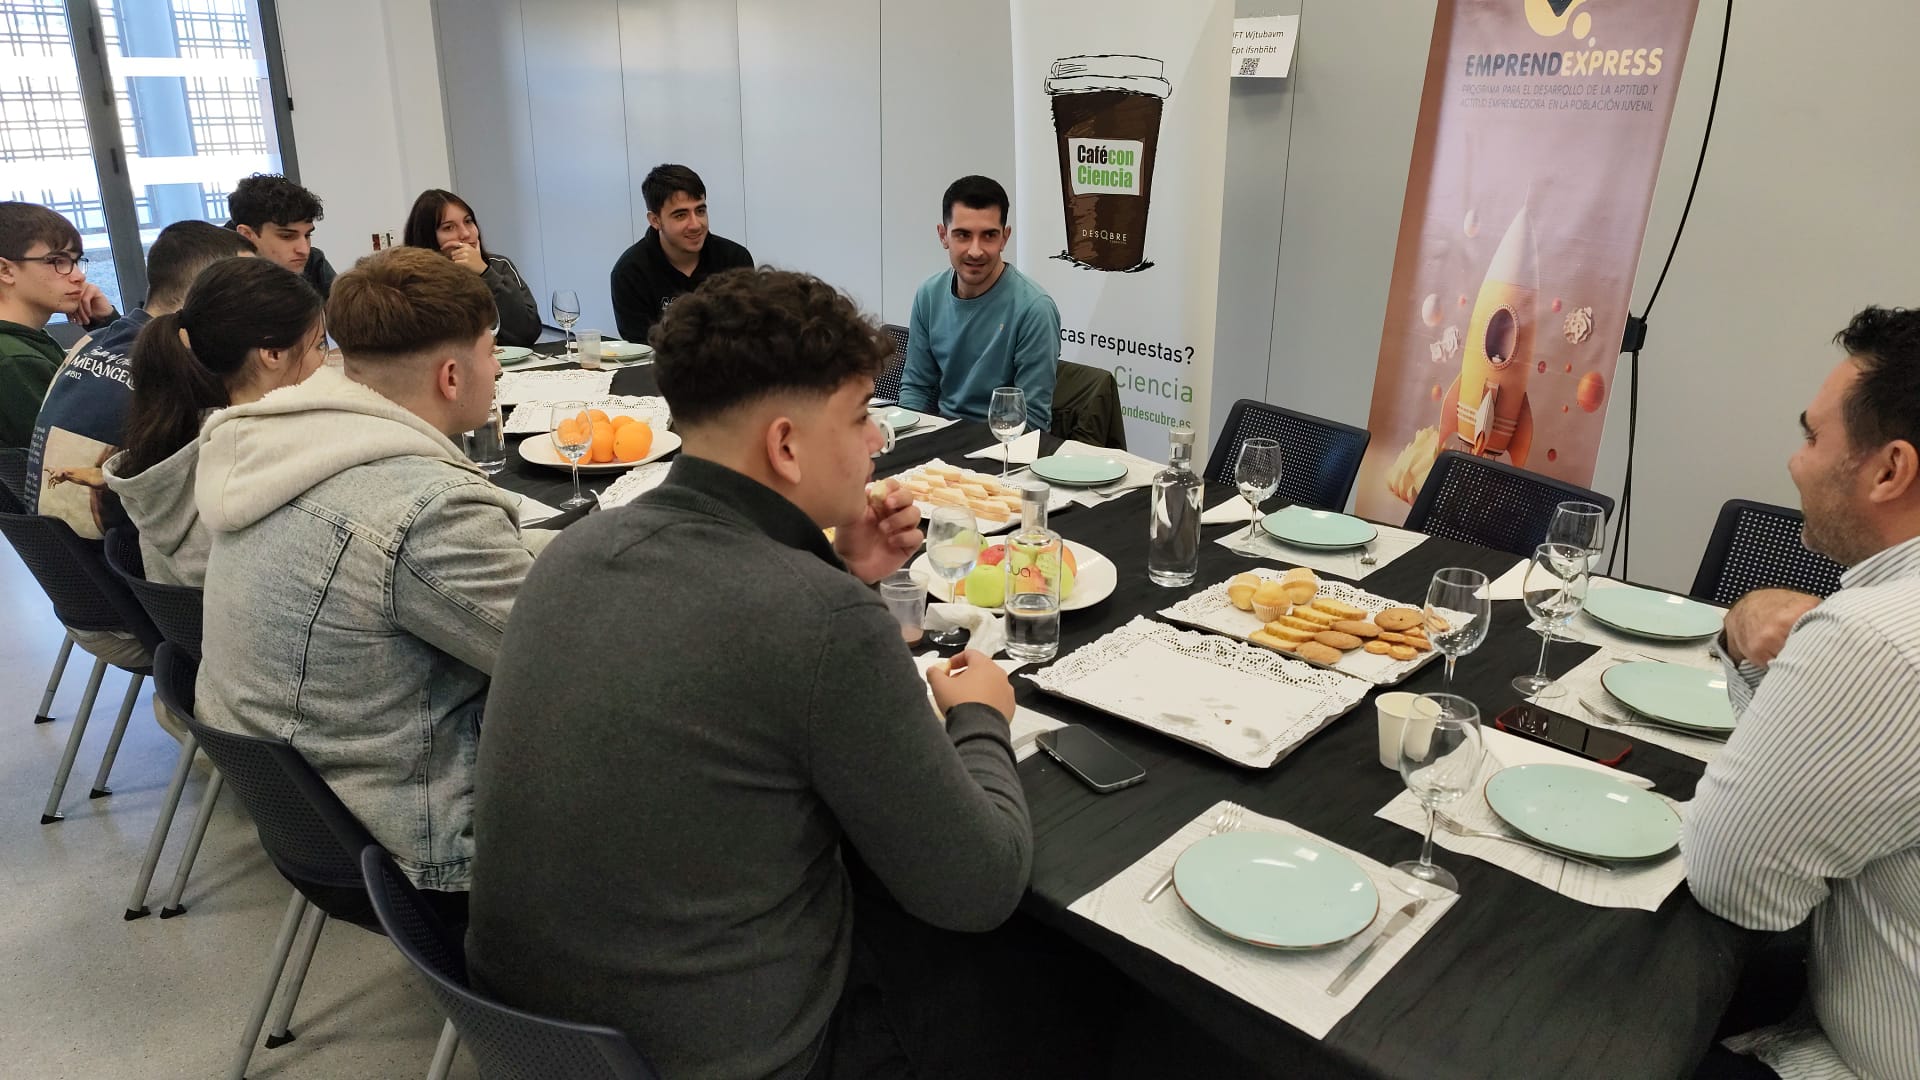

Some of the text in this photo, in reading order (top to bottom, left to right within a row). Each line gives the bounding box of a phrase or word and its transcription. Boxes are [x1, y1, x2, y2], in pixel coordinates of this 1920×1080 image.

[1465, 47, 1664, 77] EMPRENDEXPRESS
[1502, 84, 1521, 94] PARA
[1522, 85, 1531, 95] EL
[1533, 84, 1584, 96] DESARROLLO
[1586, 84, 1599, 96] DE
[1600, 84, 1611, 96] LA
[1614, 84, 1649, 96] APTITUD
[1652, 84, 1659, 96] Y
[1488, 98, 1545, 110] EMPRENDEDORA
[1547, 99, 1558, 111] EN
[1559, 99, 1569, 110] LA
[1570, 98, 1620, 112] POBLACIÓN
[1620, 99, 1655, 112] JUVENIL
[1077, 165, 1133, 188] Ciencia
[1090, 332, 1195, 365] respuestas?
[1114, 365, 1194, 403] Ciencia
